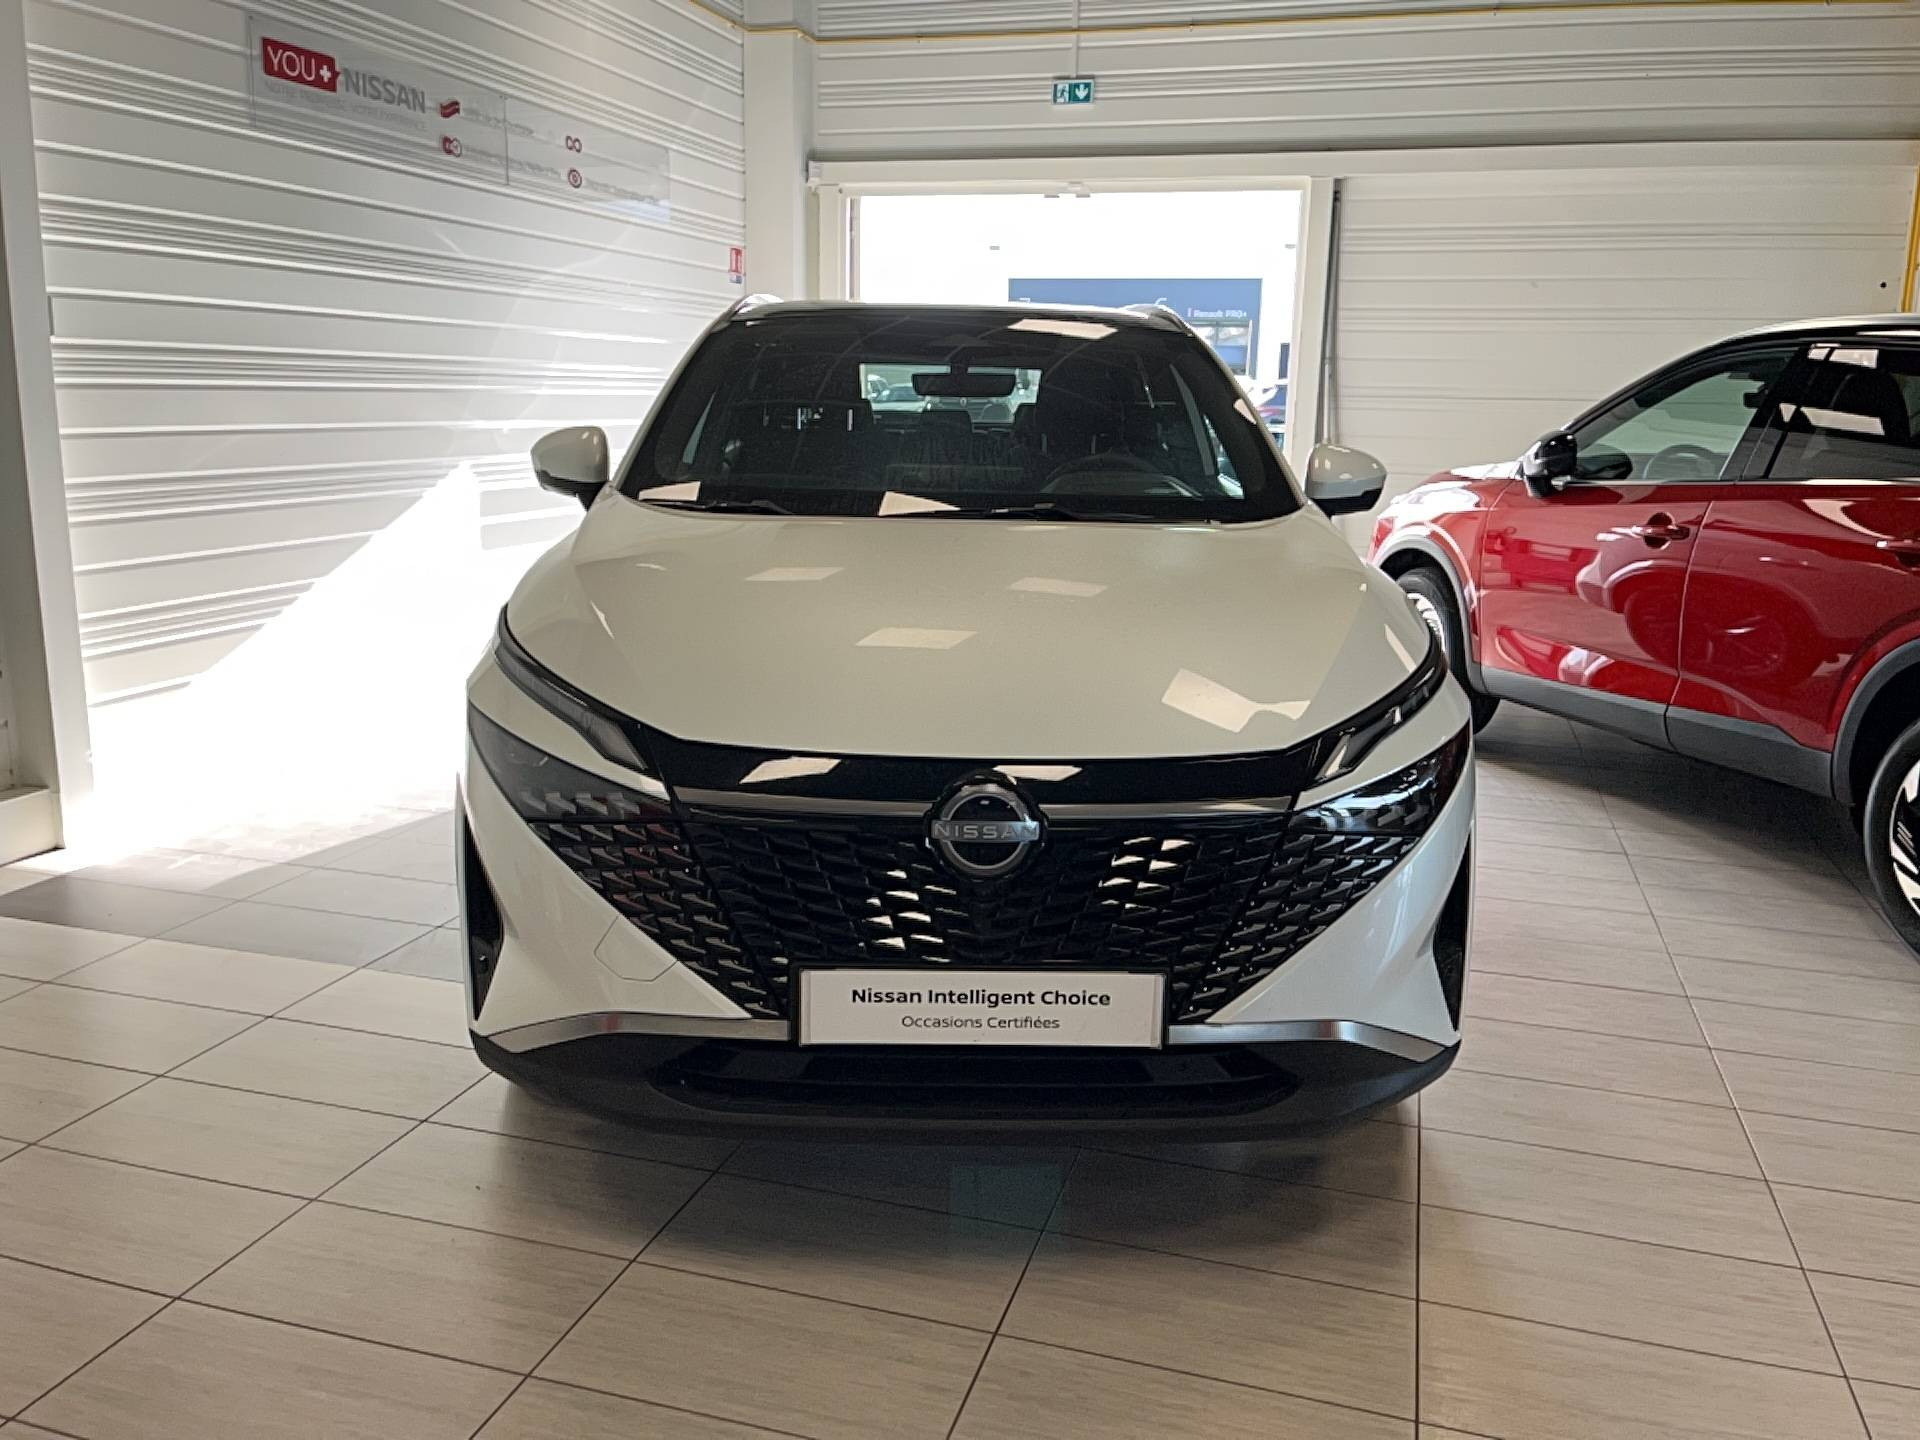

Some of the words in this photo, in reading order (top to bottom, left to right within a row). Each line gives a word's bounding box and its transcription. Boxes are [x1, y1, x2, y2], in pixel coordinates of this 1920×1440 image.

[342, 67, 426, 113] NISSAN
[852, 988, 922, 1004] Nissan
[928, 989, 1036, 1009] Intelligent
[1040, 990, 1111, 1005] Choice
[901, 1015, 982, 1028] Occasions
[986, 1016, 1060, 1029] Certifiées
